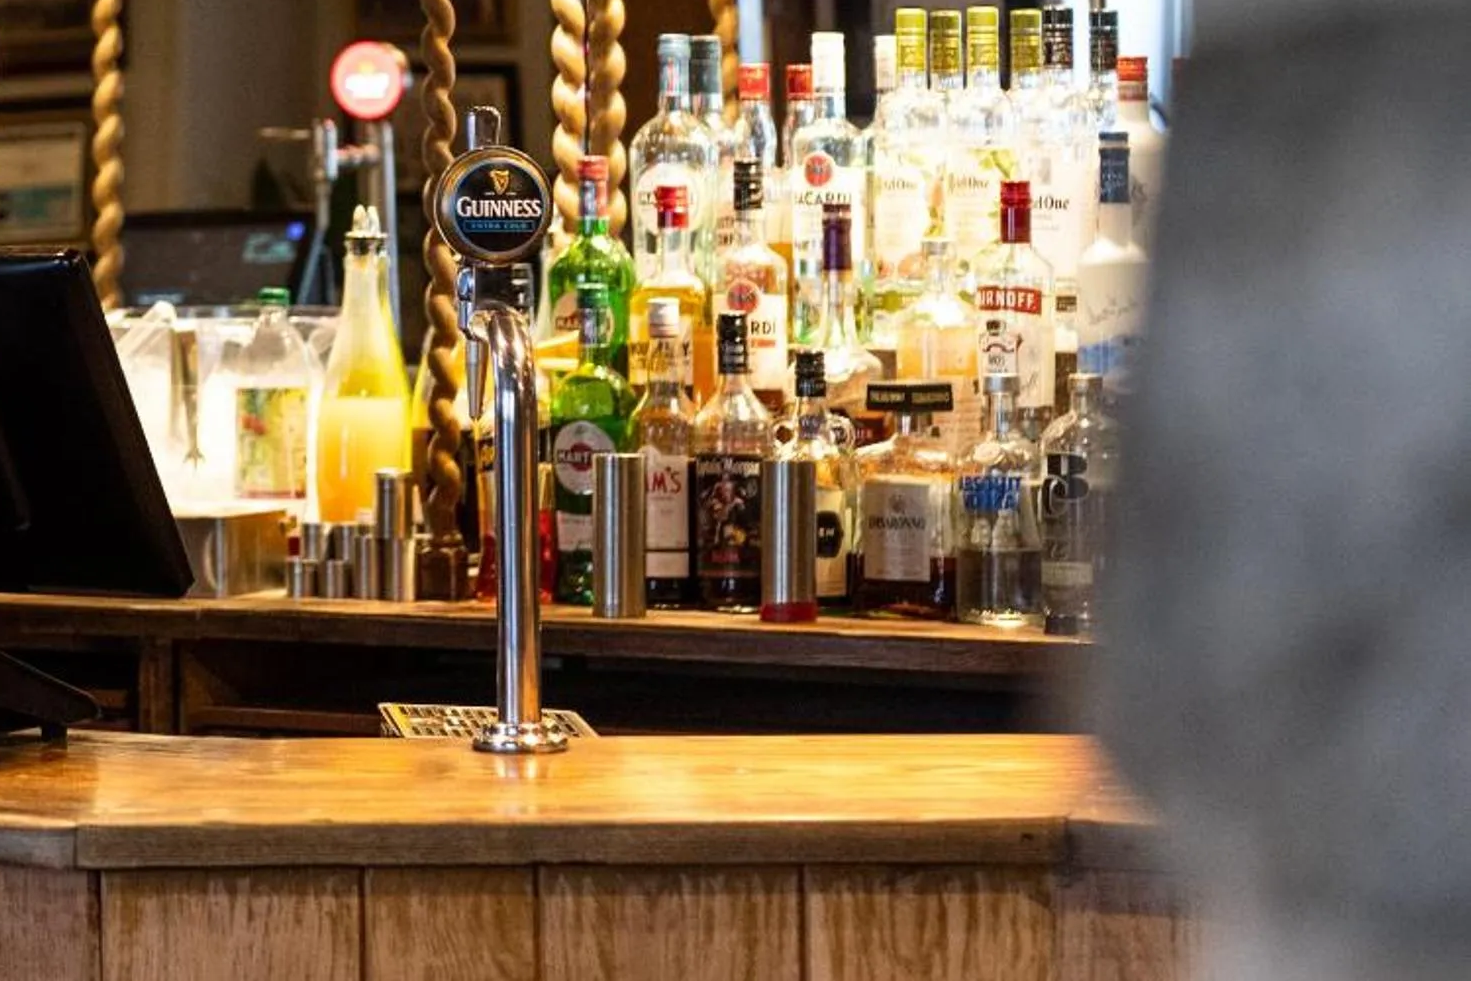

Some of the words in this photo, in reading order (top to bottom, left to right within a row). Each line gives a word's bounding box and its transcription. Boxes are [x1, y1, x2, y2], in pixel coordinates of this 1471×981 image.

[456, 195, 543, 218] GUINNESS
[977, 287, 1037, 311] IRNOFF
[557, 449, 592, 465] MART
